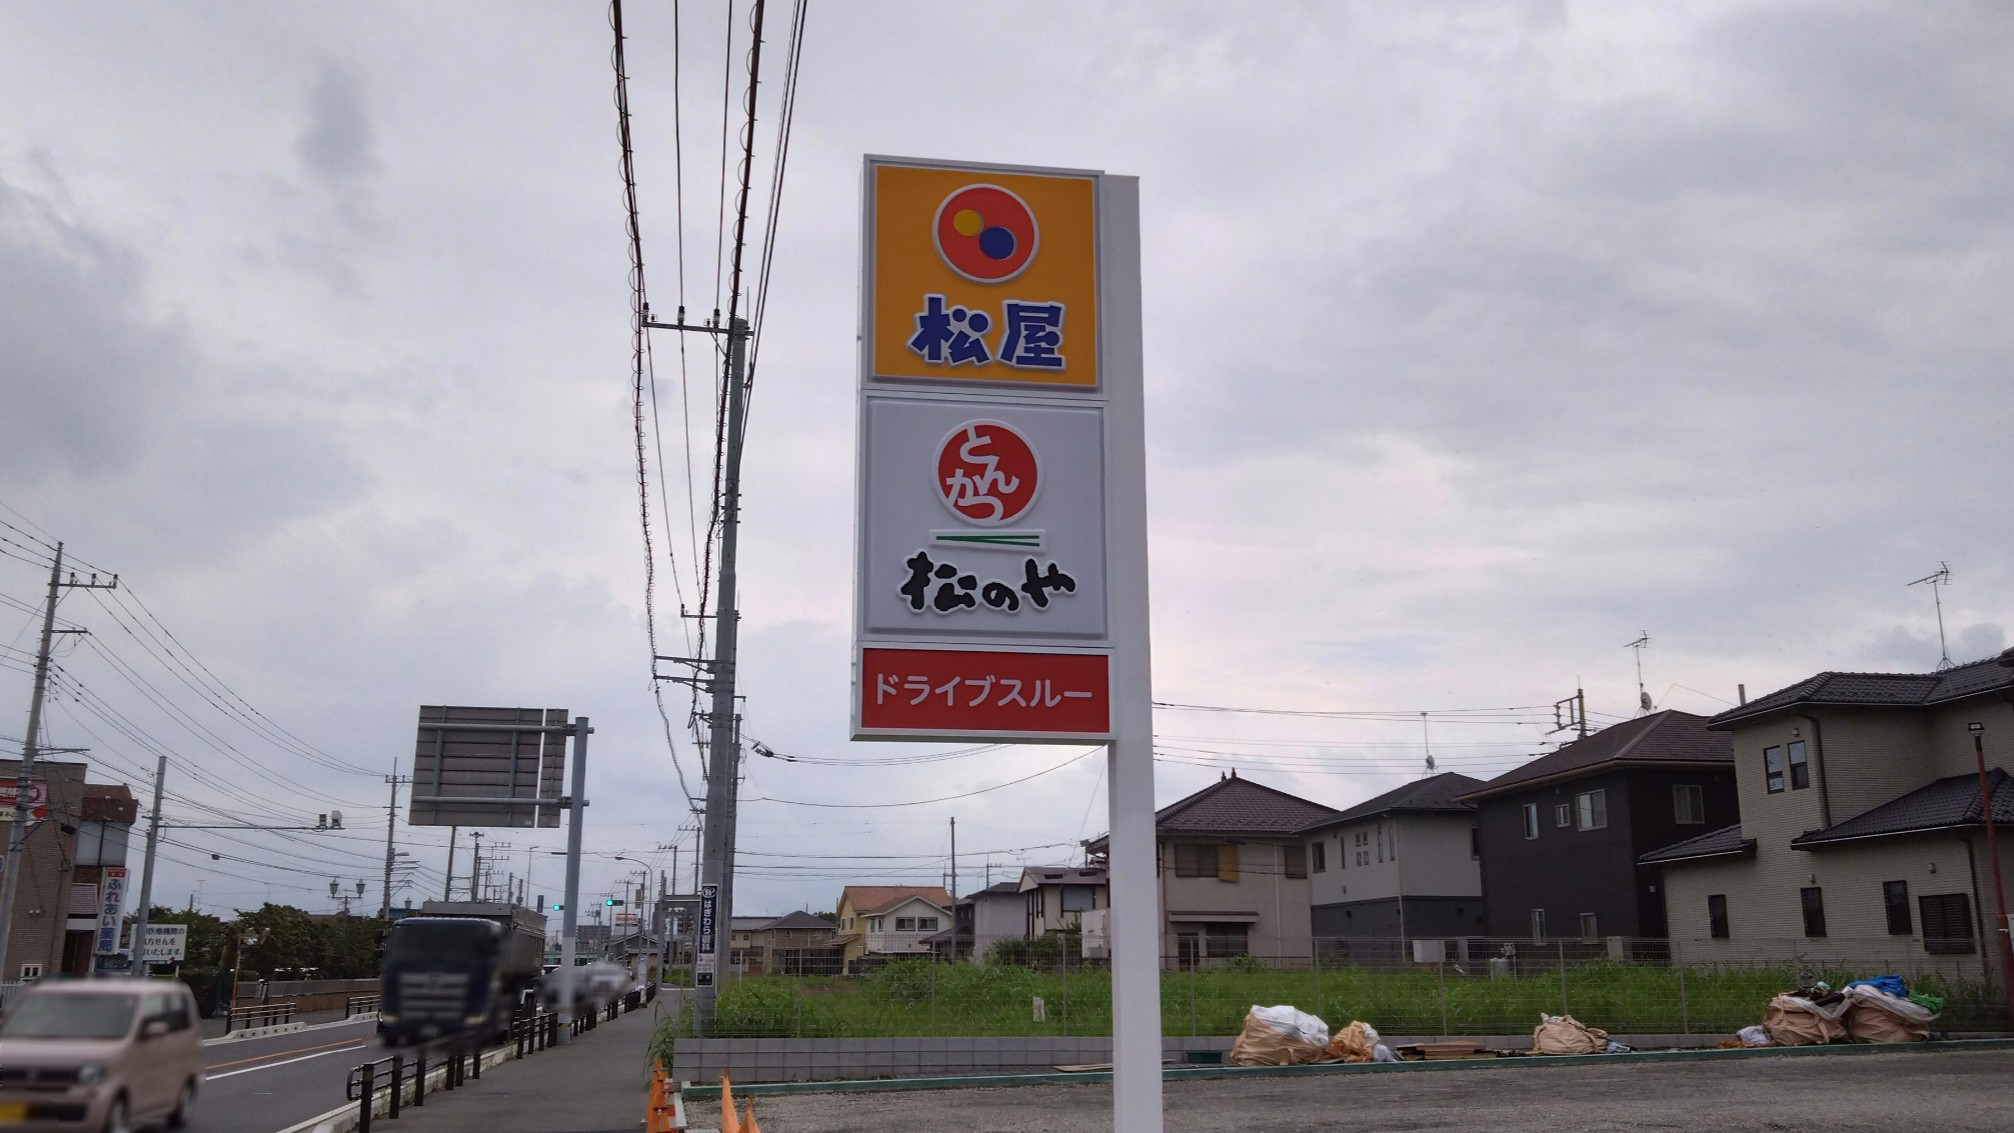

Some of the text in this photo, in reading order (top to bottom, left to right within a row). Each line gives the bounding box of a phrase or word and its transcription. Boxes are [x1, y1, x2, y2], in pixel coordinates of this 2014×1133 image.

[910, 295, 1065, 368] 松屋
[902, 551, 1077, 613] 松のや
[876, 672, 1093, 710] ドライブスルー
[98, 878, 122, 952] ふれあい薬局
